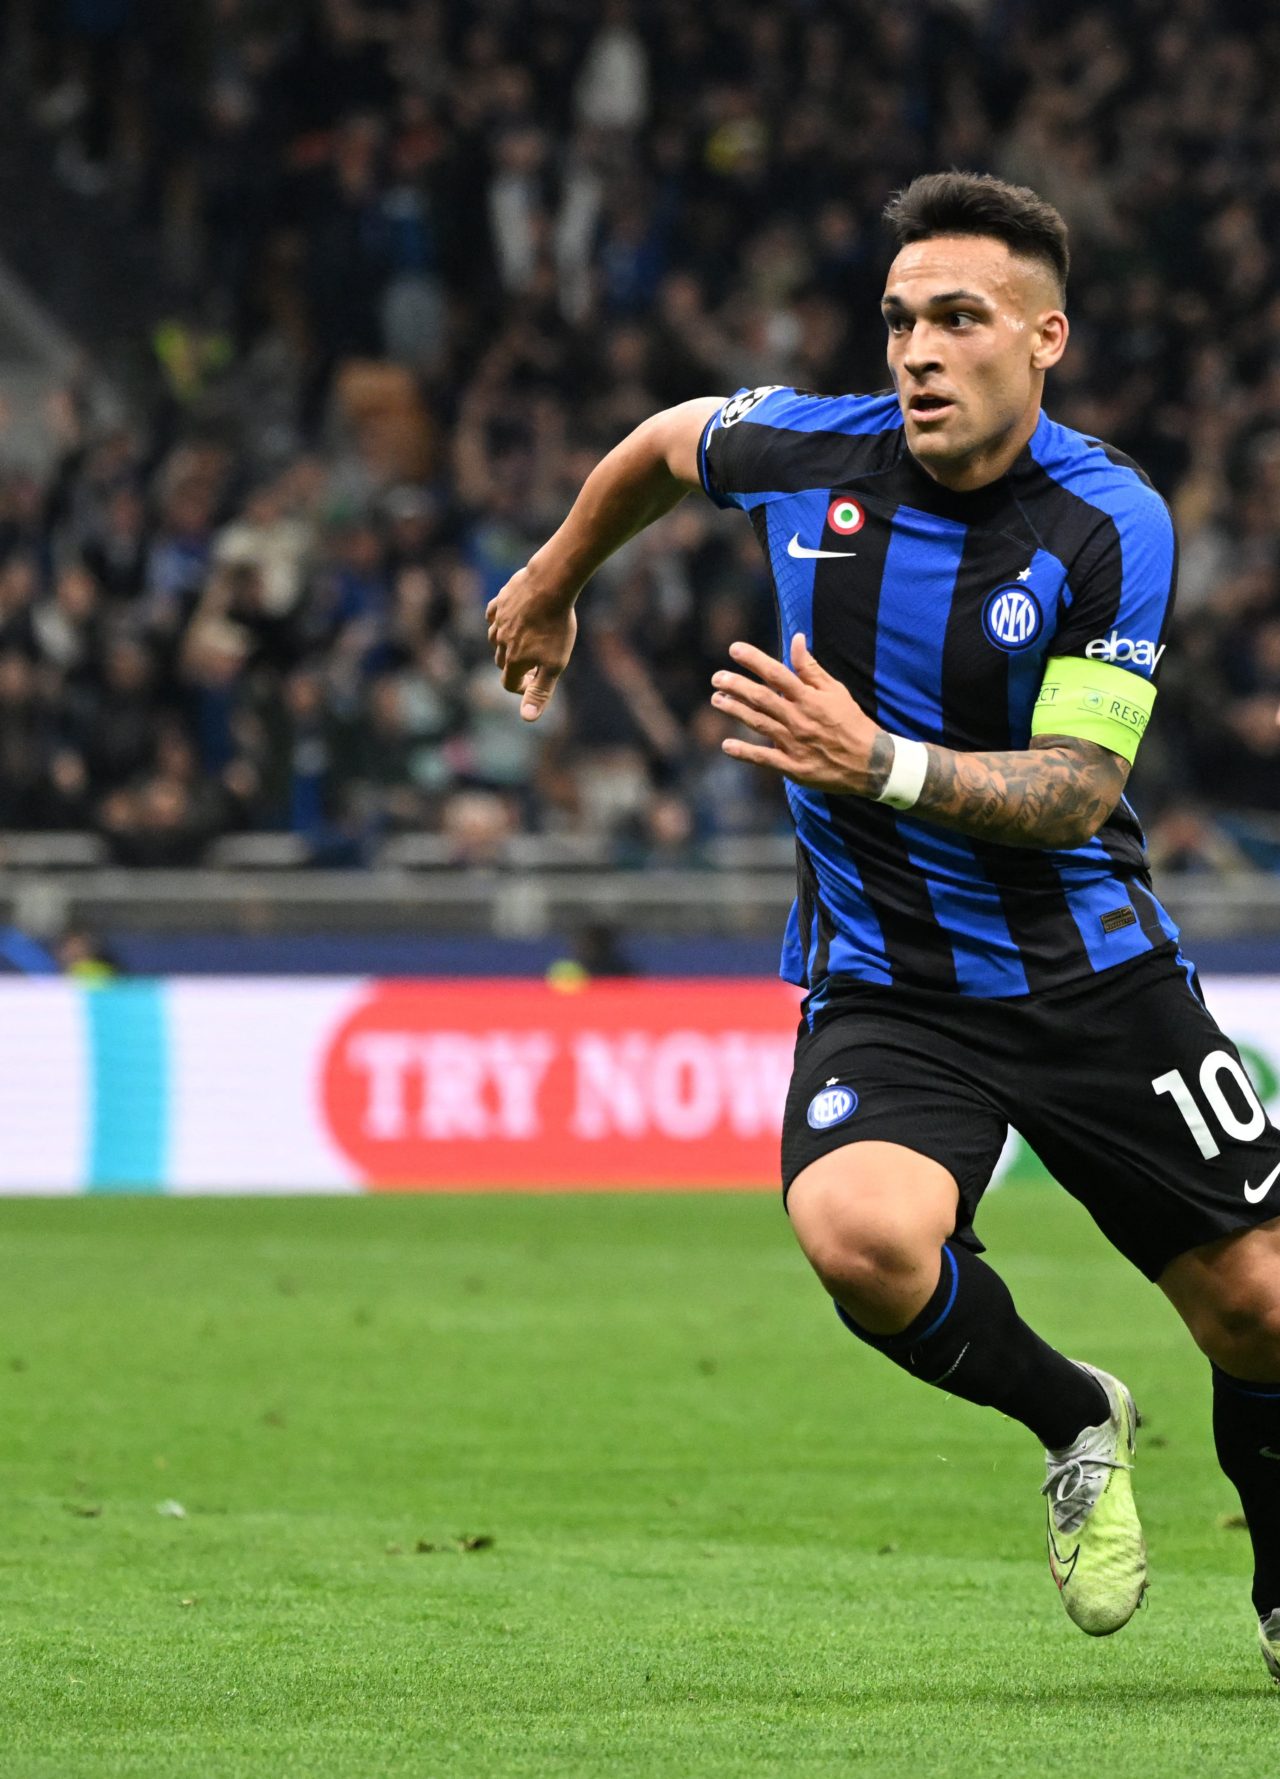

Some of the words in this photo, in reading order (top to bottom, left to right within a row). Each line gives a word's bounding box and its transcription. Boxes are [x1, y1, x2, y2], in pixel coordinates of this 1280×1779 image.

[1085, 630, 1167, 675] ebay
[346, 1030, 556, 1140] TRY
[1151, 1050, 1266, 1160] 10
